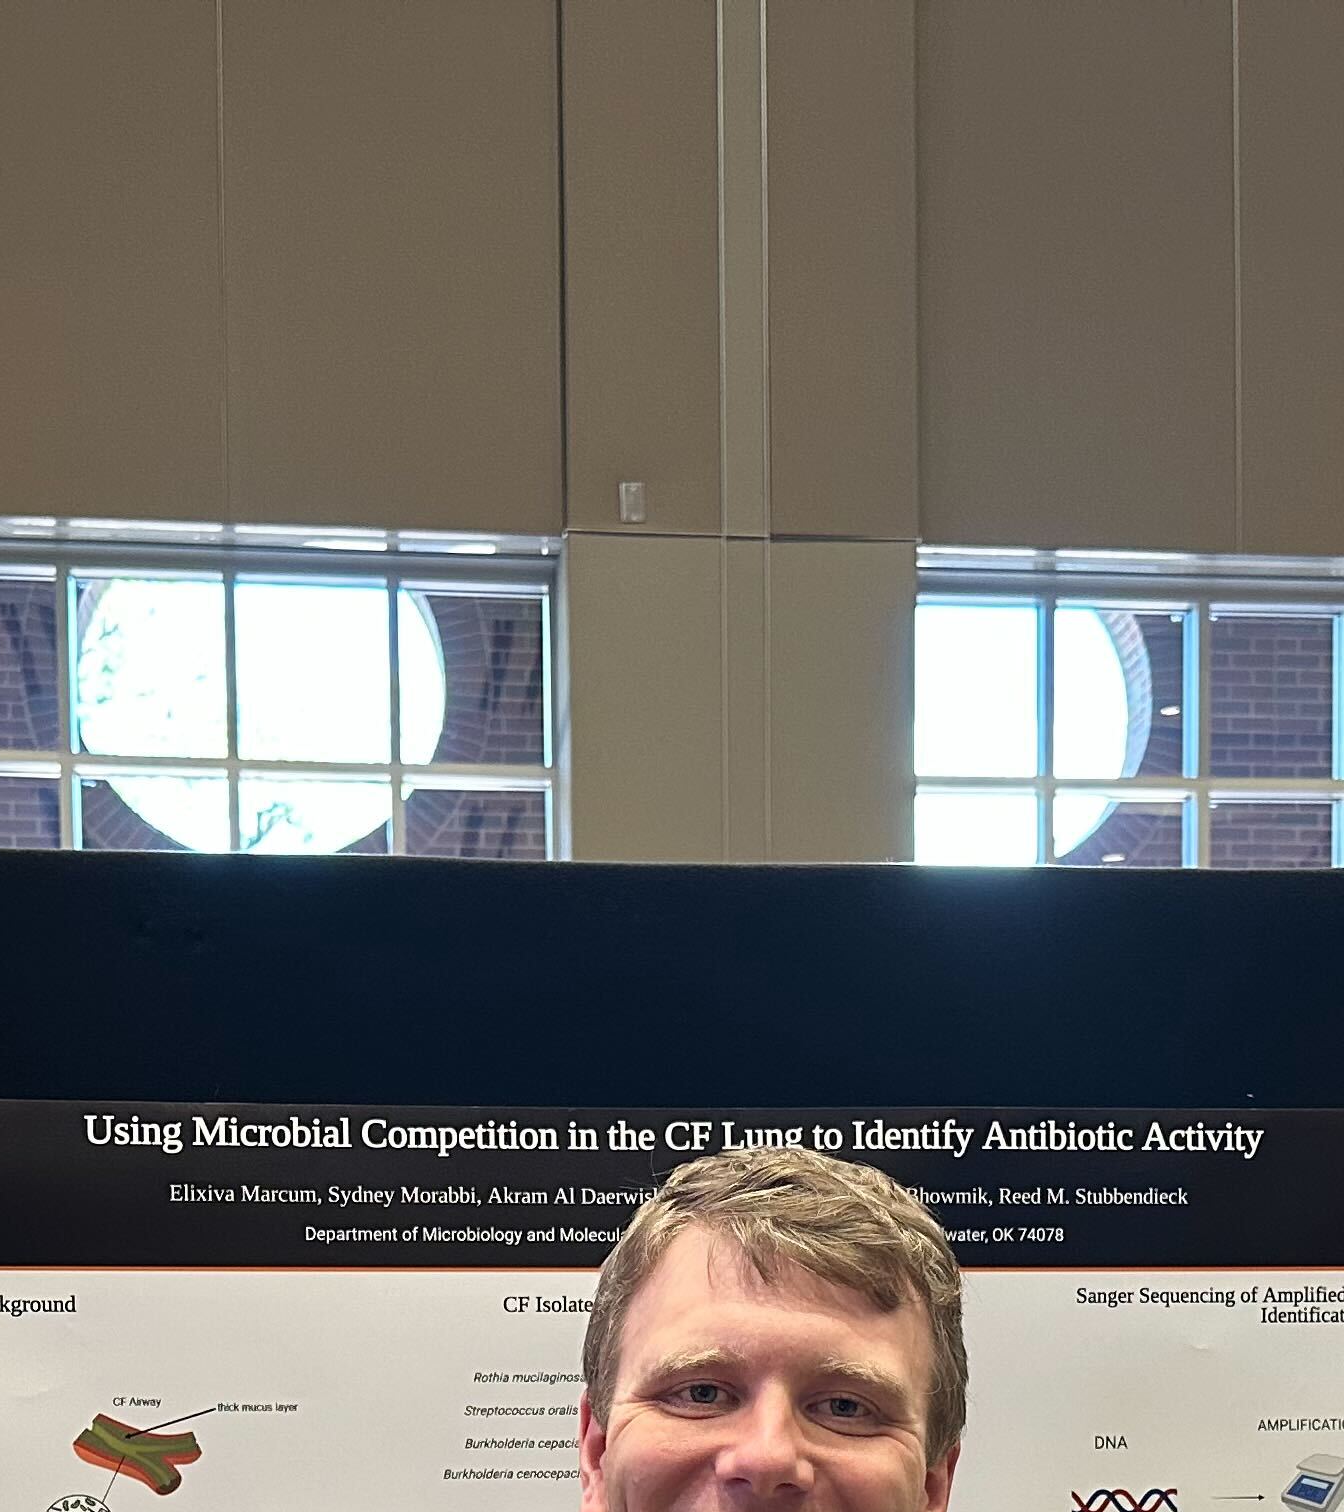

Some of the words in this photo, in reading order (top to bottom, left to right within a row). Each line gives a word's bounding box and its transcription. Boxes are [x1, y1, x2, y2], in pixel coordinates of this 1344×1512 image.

[83, 1114, 184, 1154] Using
[191, 1116, 353, 1148] Microbial
[361, 1118, 560, 1157] Competition
[567, 1120, 600, 1151] in
[606, 1120, 656, 1151] the
[663, 1121, 713, 1151] CF
[720, 1121, 804, 1150] Lung
[811, 1124, 845, 1150] to
[851, 1118, 975, 1158] Identify
[981, 1119, 1134, 1151] Antibiotic
[1140, 1121, 1265, 1160] Activity
[169, 1183, 235, 1202] Elixiva
[240, 1184, 322, 1206] Marcum,
[328, 1185, 395, 1208] Sydney
[400, 1185, 482, 1207] Morabbi,
[487, 1186, 548, 1205] Akram
[553, 1187, 576, 1205] Al
[999, 1186, 1042, 1205] Reed
[1046, 1187, 1070, 1205] M.
[1075, 1187, 1189, 1205] Stubbendieck
[305, 1226, 398, 1245] Department
[401, 1225, 419, 1242] of
[422, 1226, 523, 1246] Microbiology
[526, 1226, 555, 1242] and
[992, 1227, 1015, 1242] OK
[1017, 1227, 1065, 1242] 74078
[503, 1295, 530, 1313] CF
[1076, 1287, 1135, 1309] Sanger
[1139, 1286, 1236, 1308] Sequencing
[1240, 1285, 1259, 1304] of
[473, 1371, 510, 1383] Rothia
[463, 1405, 546, 1419] Streptococcus
[547, 1404, 579, 1416] oralis
[464, 1437, 536, 1450] Burkholderia
[1094, 1435, 1129, 1450] DNA
